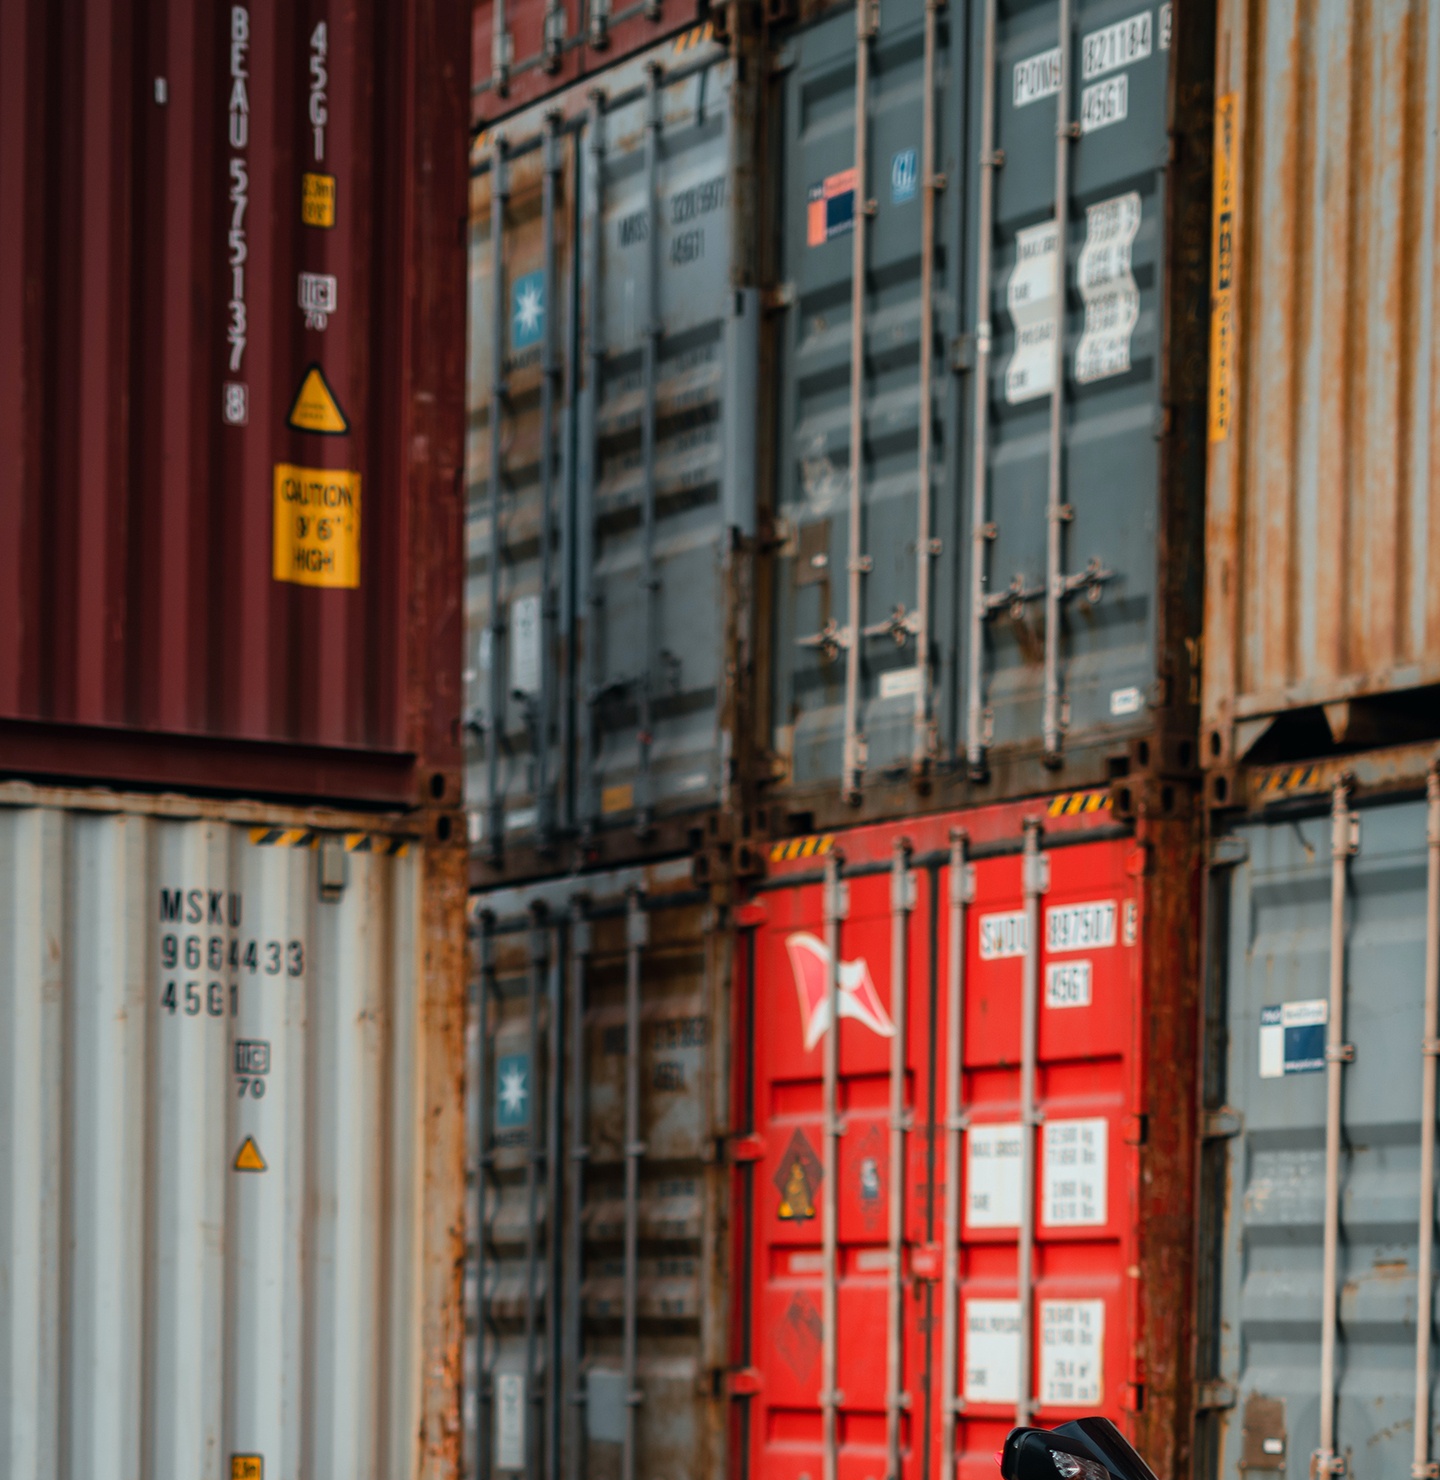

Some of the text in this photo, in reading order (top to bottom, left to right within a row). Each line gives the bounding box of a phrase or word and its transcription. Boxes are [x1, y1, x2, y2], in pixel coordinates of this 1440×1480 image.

[225, 5, 249, 423] BEAU 575137 8
[282, 478, 353, 507] CAUTION
[160, 888, 242, 928] MSKU
[161, 933, 305, 977] 9664433
[236, 1077, 265, 1099] 70
